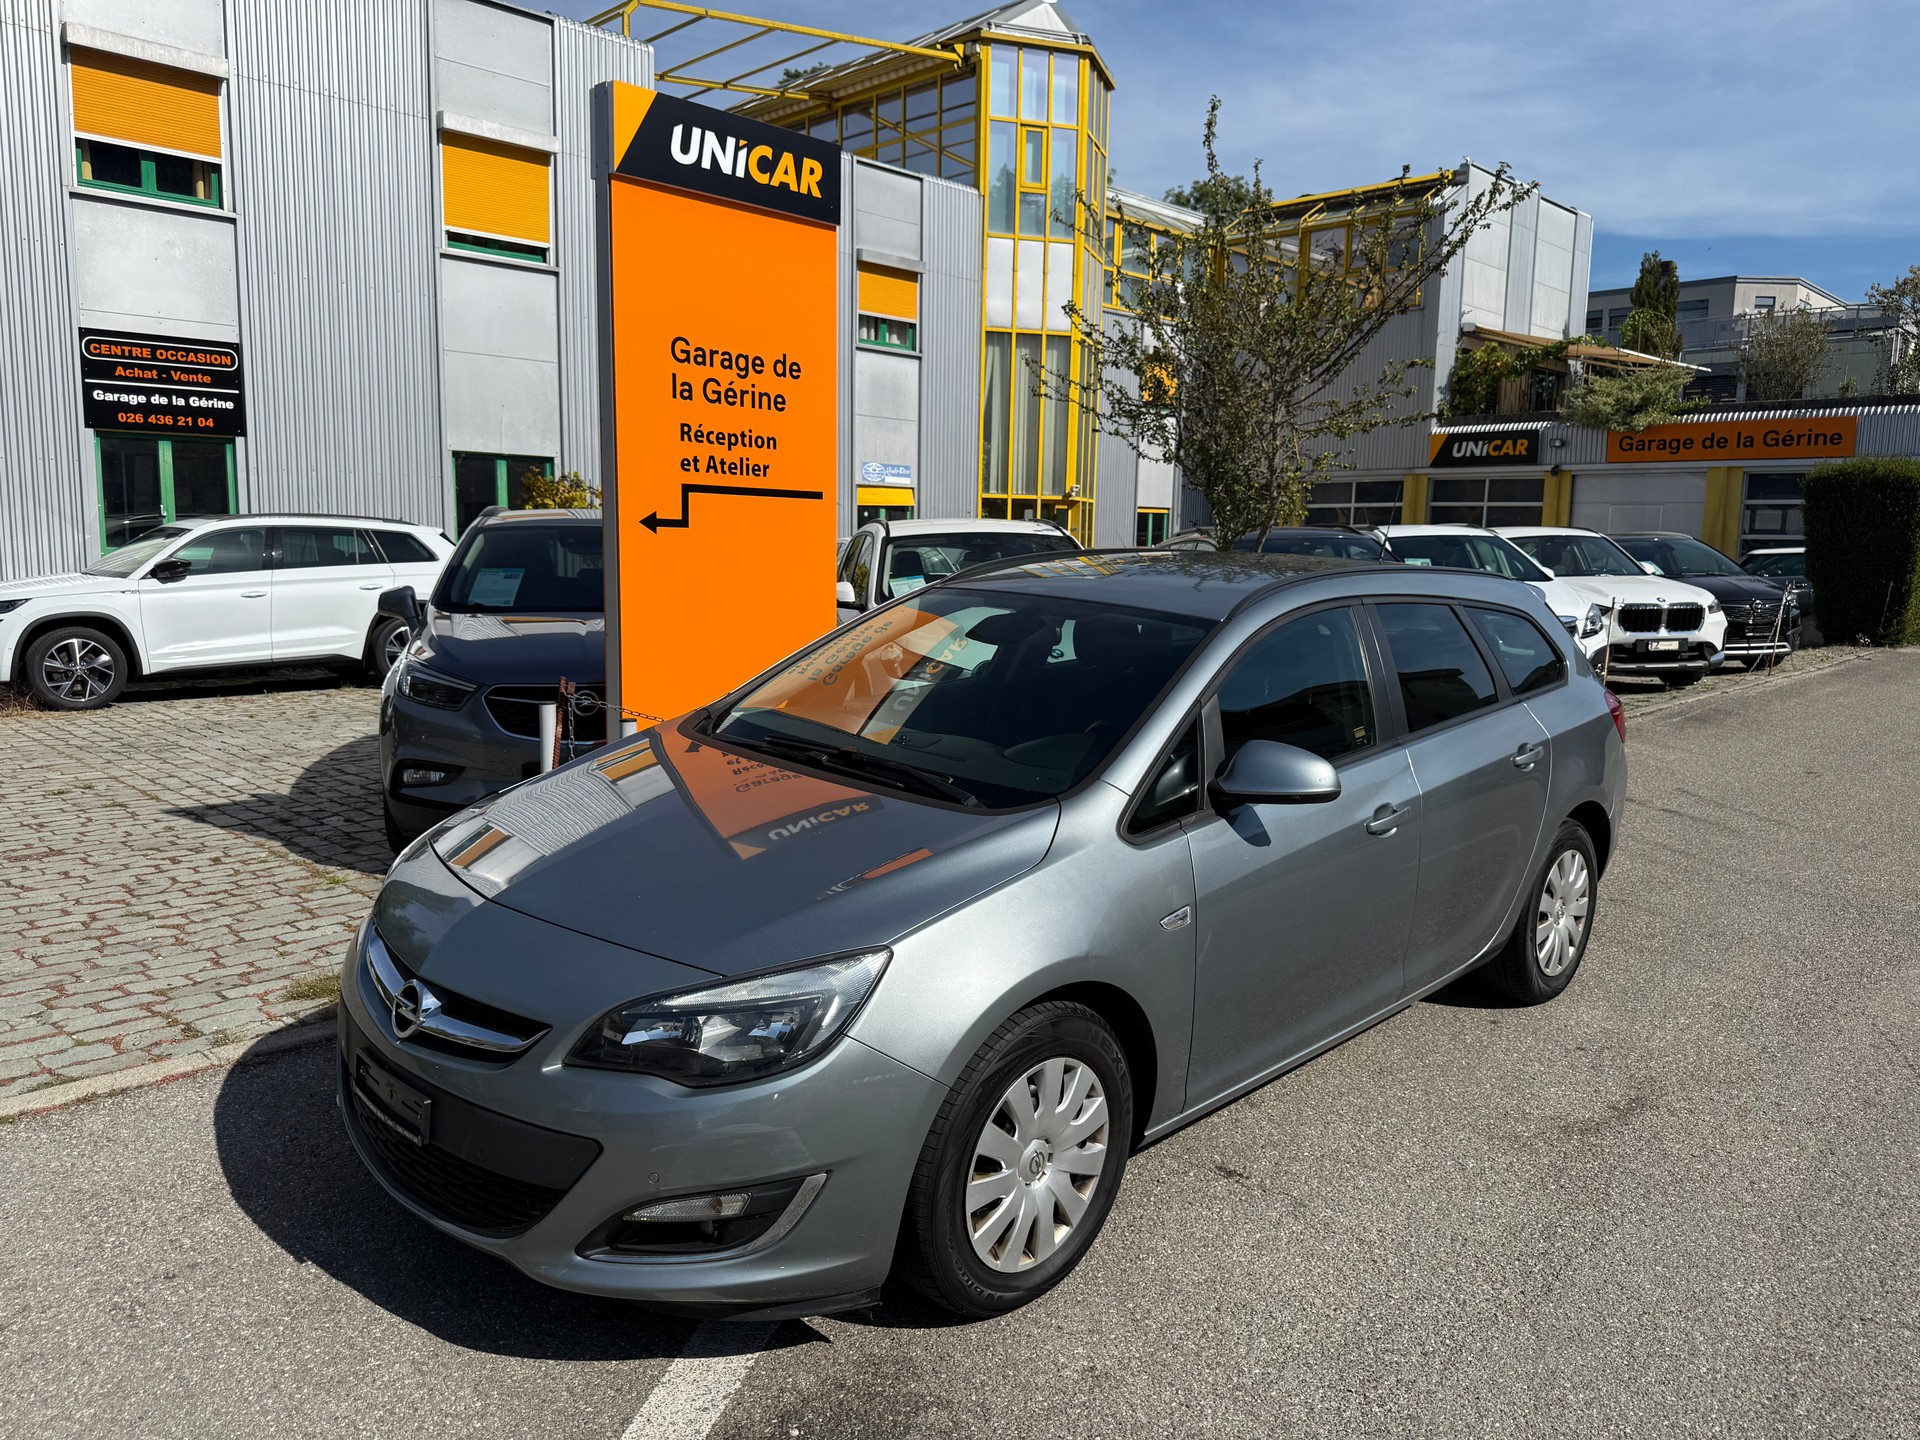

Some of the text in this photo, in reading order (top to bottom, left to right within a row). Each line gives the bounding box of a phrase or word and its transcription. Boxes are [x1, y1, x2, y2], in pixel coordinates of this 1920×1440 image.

[89, 343, 232, 366] CENTRE OCCASION
[670, 336, 802, 380] Garage de
[114, 366, 158, 380] Achat
[170, 370, 212, 384] Vente
[92, 389, 235, 410] Garage de la Gérine
[671, 372, 787, 413] la Gérine
[117, 412, 215, 428] 026 436 21 04
[679, 422, 777, 452] Réception
[1618, 428, 1844, 455] Garage de la Gérine
[680, 454, 770, 478] et Atelier
